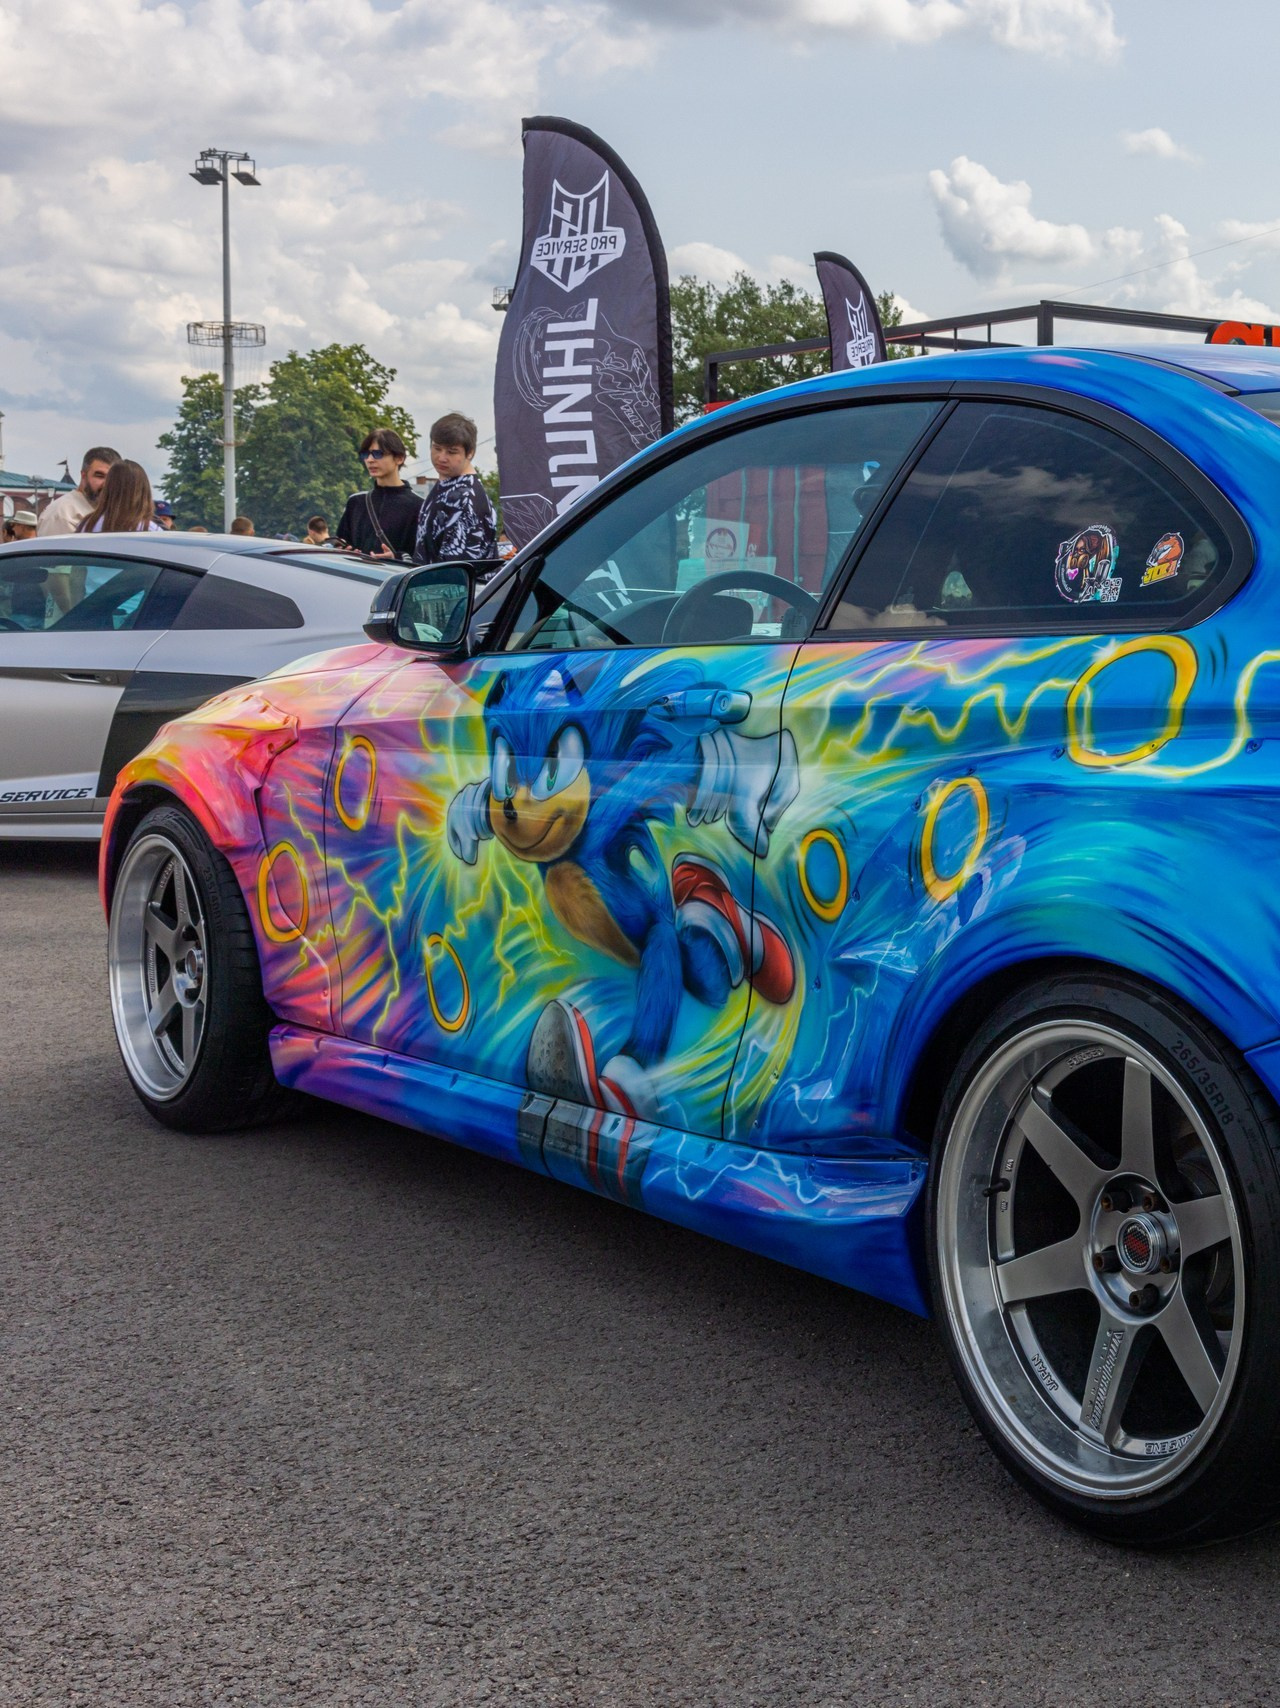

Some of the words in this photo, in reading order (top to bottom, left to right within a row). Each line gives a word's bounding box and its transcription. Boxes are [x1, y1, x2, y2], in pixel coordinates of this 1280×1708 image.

[0, 787, 93, 803] SERVICE
[1171, 1040, 1234, 1126] 265/35R18
[1031, 1353, 1059, 1392] JAPAN
